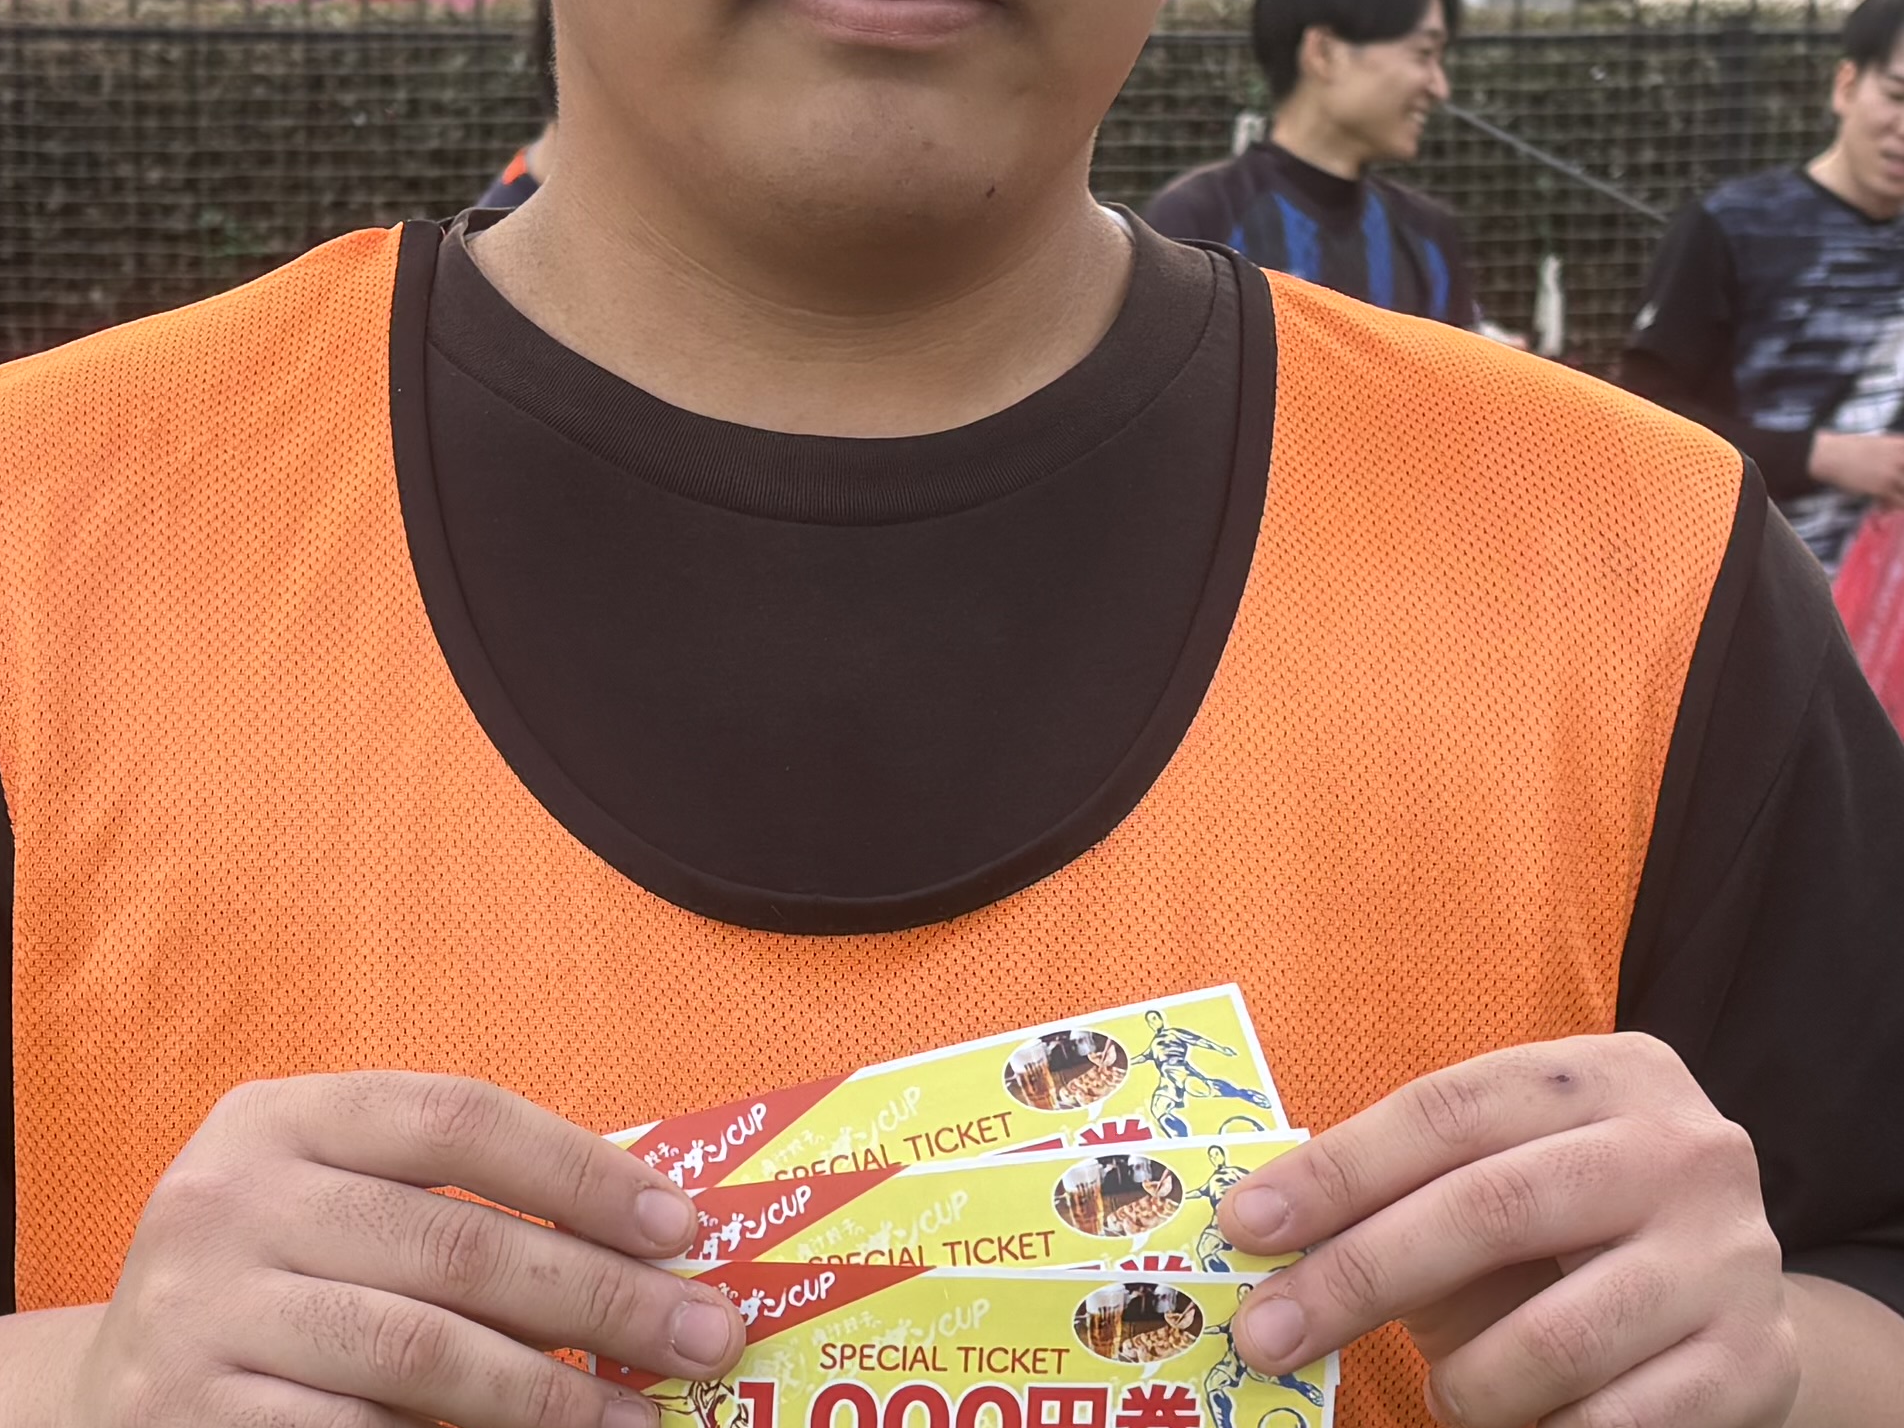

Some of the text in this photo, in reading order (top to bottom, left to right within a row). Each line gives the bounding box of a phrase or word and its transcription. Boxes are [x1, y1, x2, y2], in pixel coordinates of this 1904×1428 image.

[903, 1111, 1012, 1161] TICKET
[943, 1230, 1055, 1266] TICKET
[820, 1342, 1070, 1374] SPECIAL TICKET
